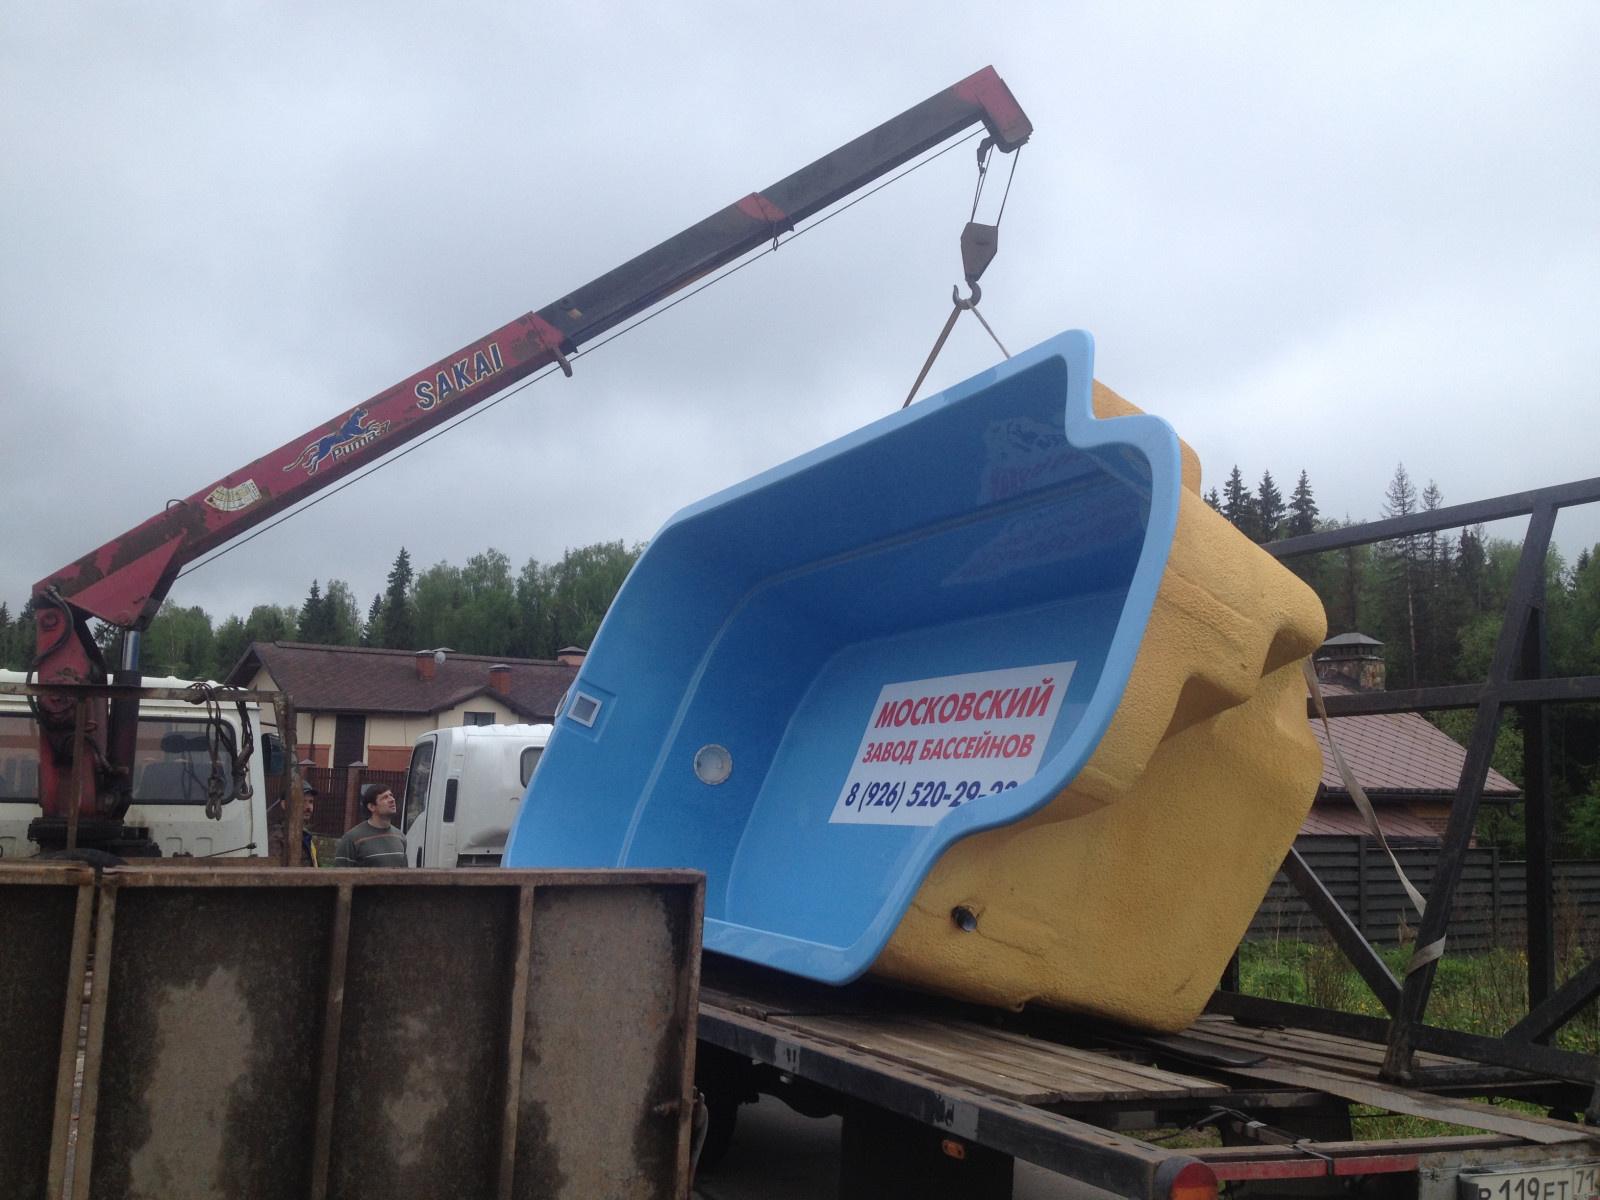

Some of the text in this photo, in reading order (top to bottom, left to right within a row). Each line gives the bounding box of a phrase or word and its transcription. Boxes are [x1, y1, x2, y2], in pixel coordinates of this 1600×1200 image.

[414, 342, 503, 411] SAKAI
[874, 677, 1054, 728] МОСКОВСКИЙ
[862, 730, 1035, 765] ЗАВОД БАССЕЙНОВ
[845, 782, 860, 807] 8
[858, 781, 906, 813] (926)
